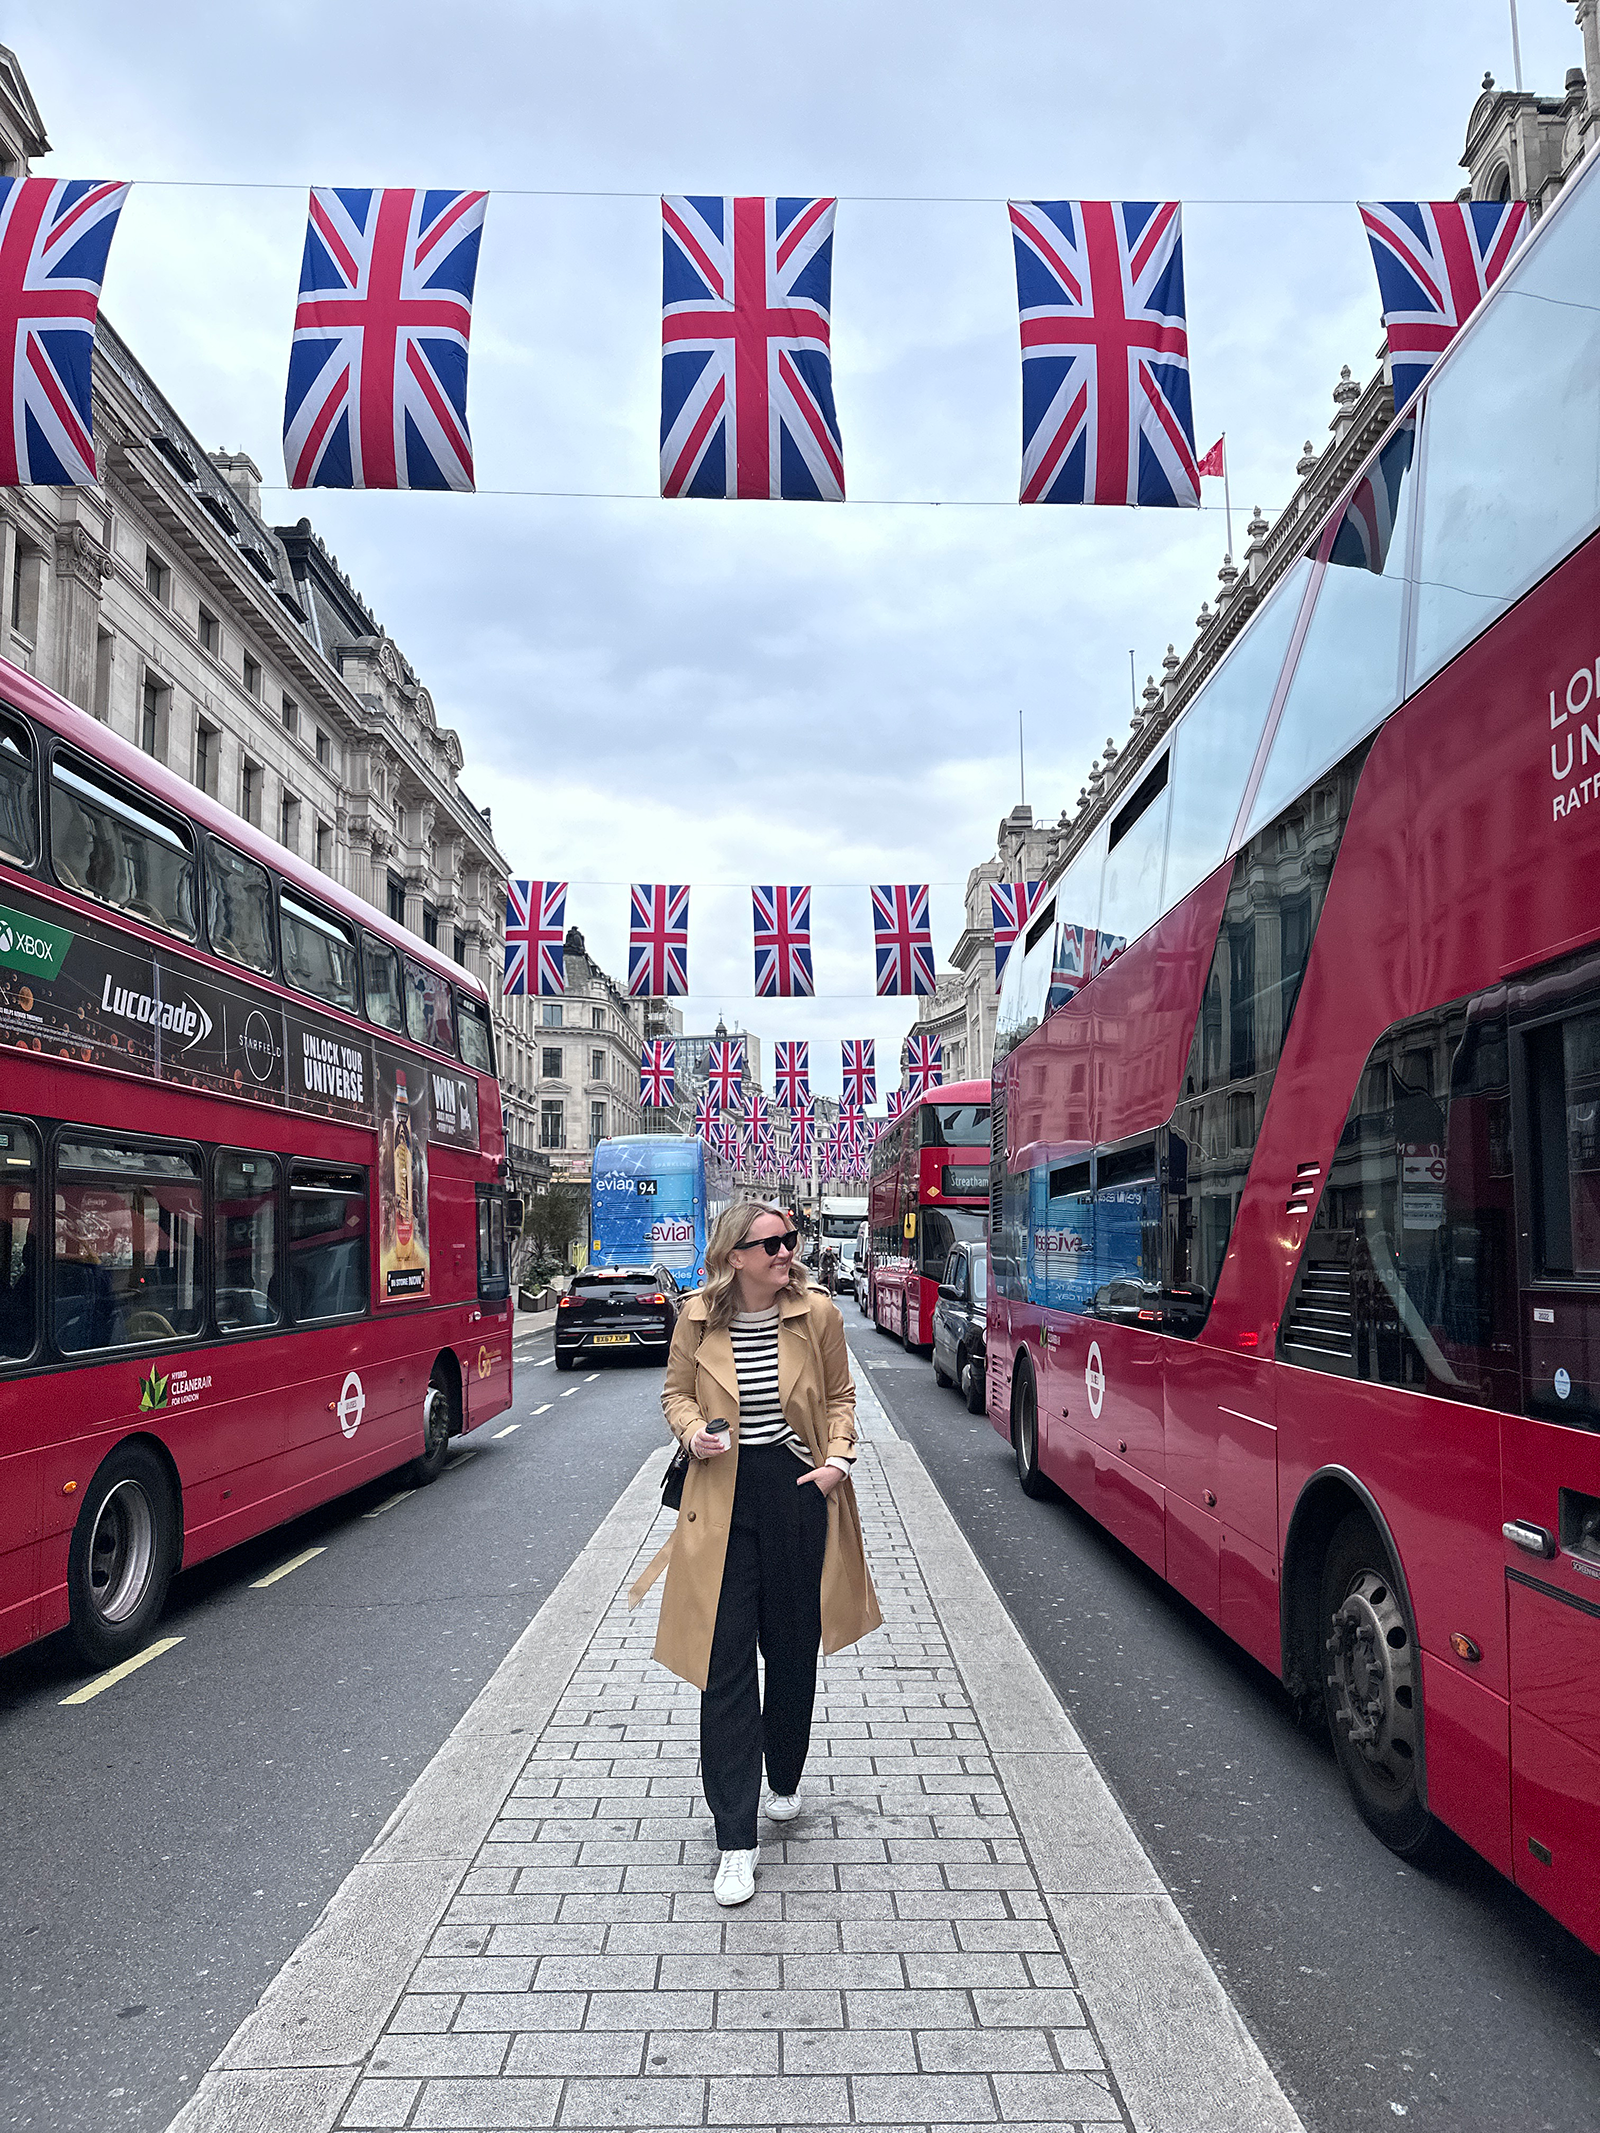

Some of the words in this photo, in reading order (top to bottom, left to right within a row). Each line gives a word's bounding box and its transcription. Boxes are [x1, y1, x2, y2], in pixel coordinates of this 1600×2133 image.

[16, 931, 53, 962] XBOX
[101, 973, 197, 1037] Lucozade
[238, 1034, 282, 1058] STARFIELD
[303, 1032, 339, 1066] UNLOCK
[341, 1046, 362, 1073] YOUR
[304, 1057, 364, 1103] UNIVERSE
[432, 1074, 456, 1114] WIN
[596, 1179, 635, 1191] evian
[639, 1182, 656, 1195] 94
[951, 1174, 989, 1187] Streatham
[651, 1223, 696, 1241] evian
[409, 1275, 421, 1286] NOW
[672, 1271, 693, 1279] kles
[171, 1397, 180, 1406] FOR
[180, 1393, 200, 1404] LONDON
